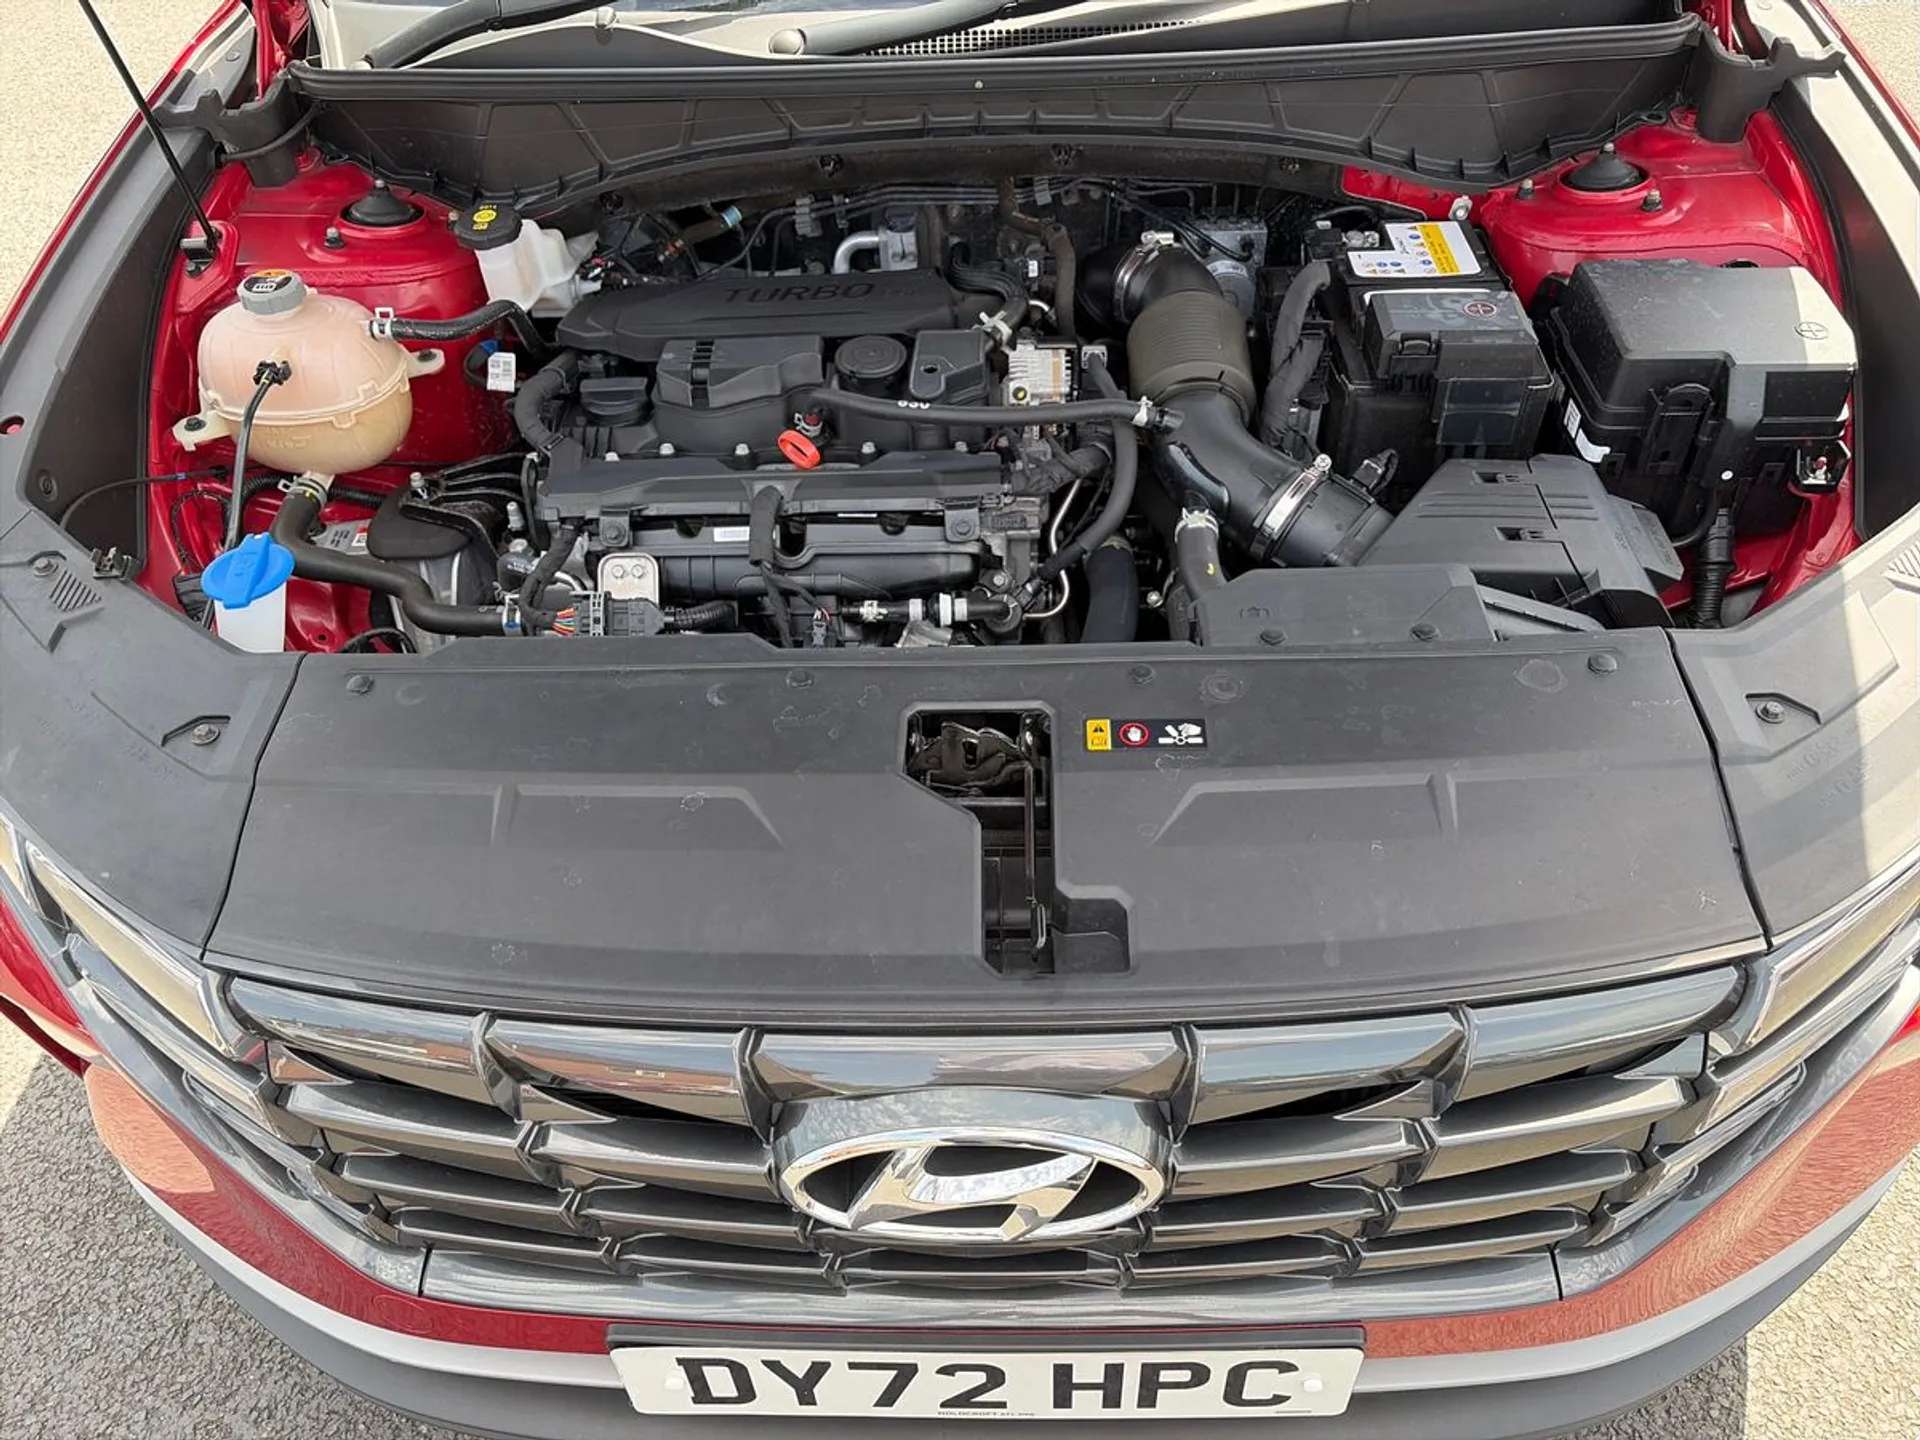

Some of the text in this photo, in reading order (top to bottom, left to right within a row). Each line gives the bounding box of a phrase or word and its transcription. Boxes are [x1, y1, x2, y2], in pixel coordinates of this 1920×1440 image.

[726, 283, 875, 302] TURBO
[676, 1357, 1299, 1409] DY72 HPC
